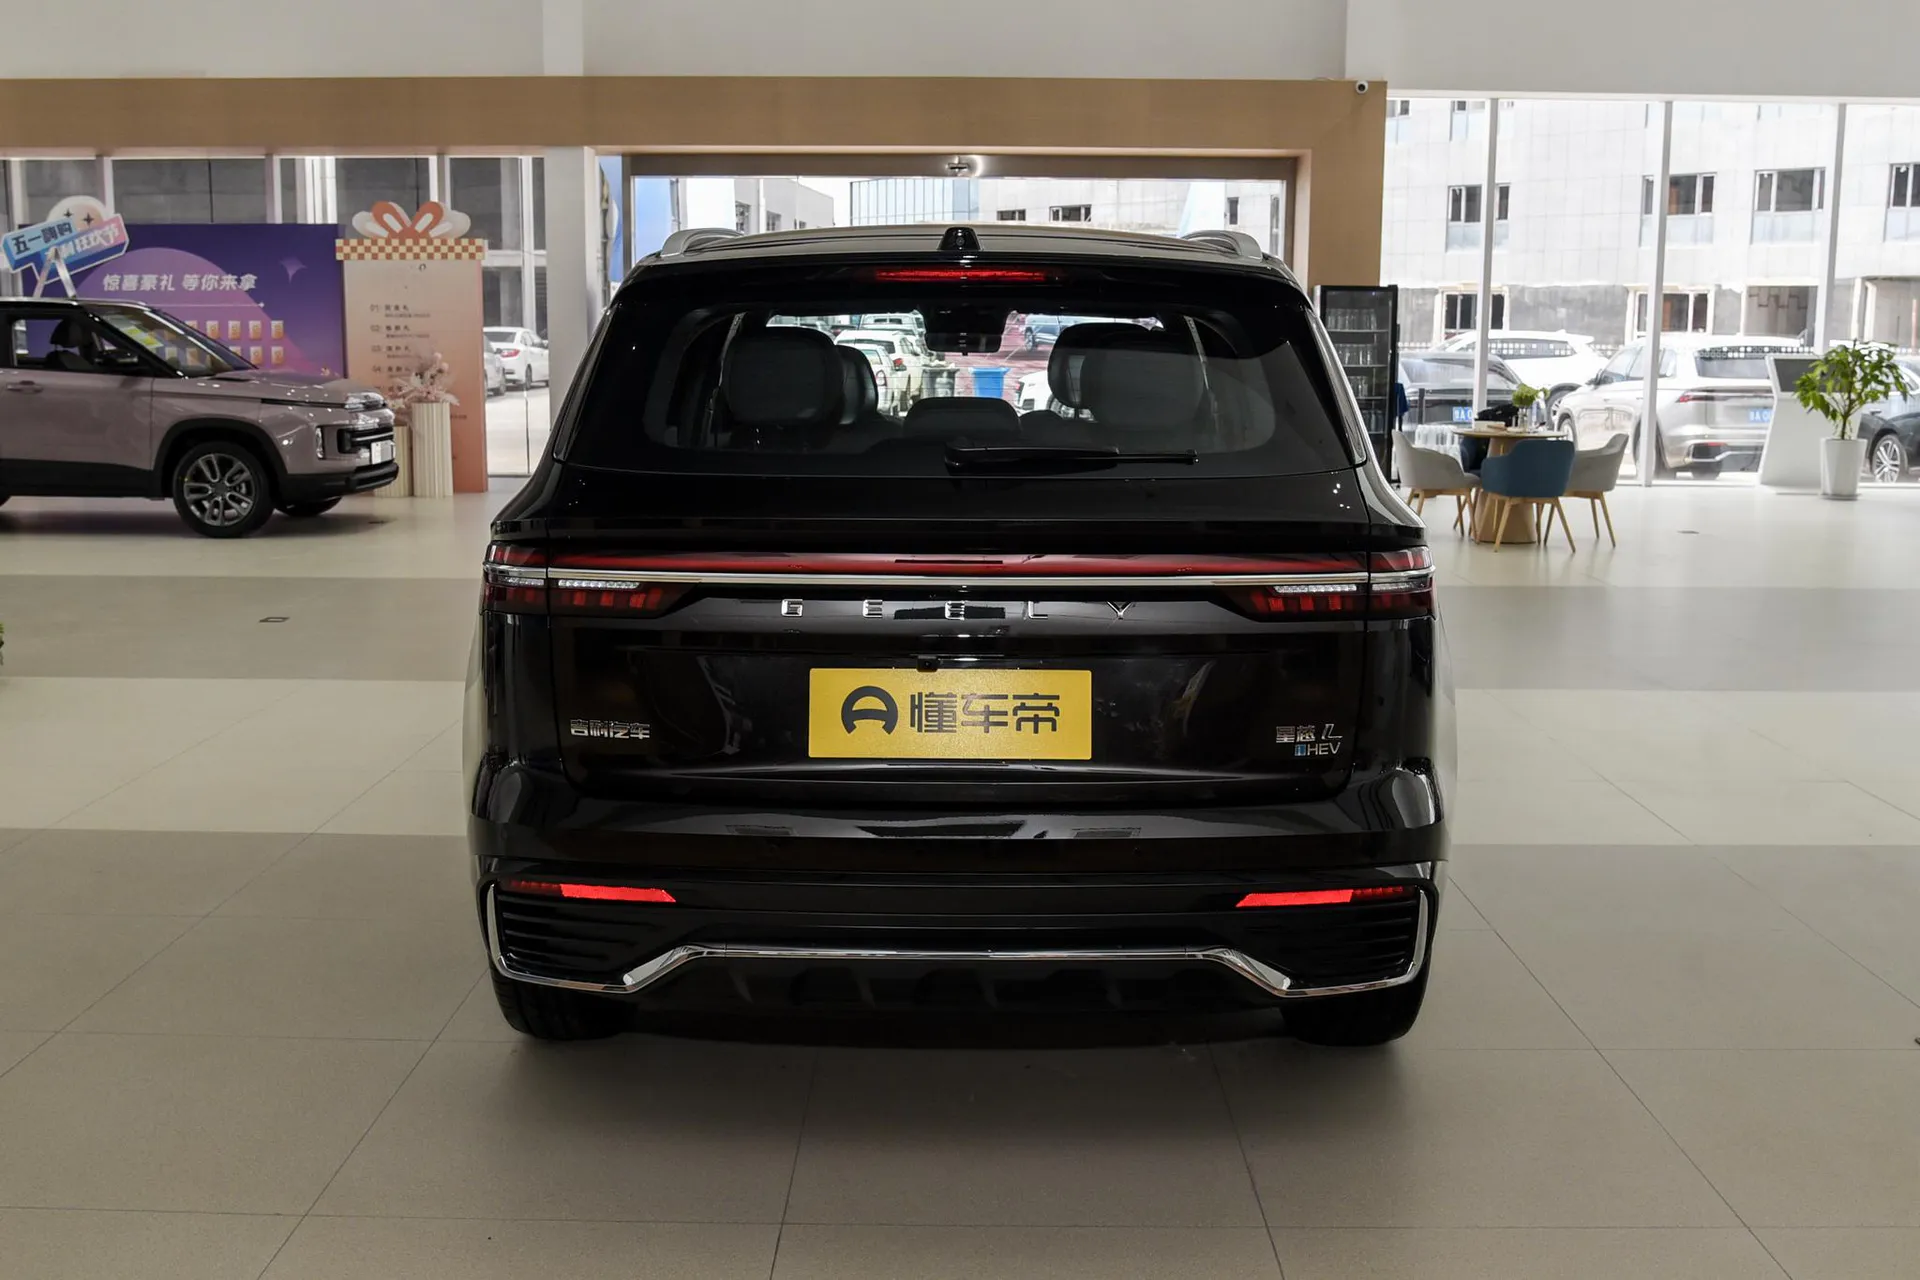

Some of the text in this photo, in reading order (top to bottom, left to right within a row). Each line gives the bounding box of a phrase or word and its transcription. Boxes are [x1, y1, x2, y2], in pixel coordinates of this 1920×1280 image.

[103, 274, 258, 291] 惊喜豪礼 等你来拿
[781, 598, 1135, 620] GEELY
[910, 692, 1060, 734] 懂车帝
[570, 719, 650, 739] 吉利汽车
[1276, 725, 1315, 743] 星越
